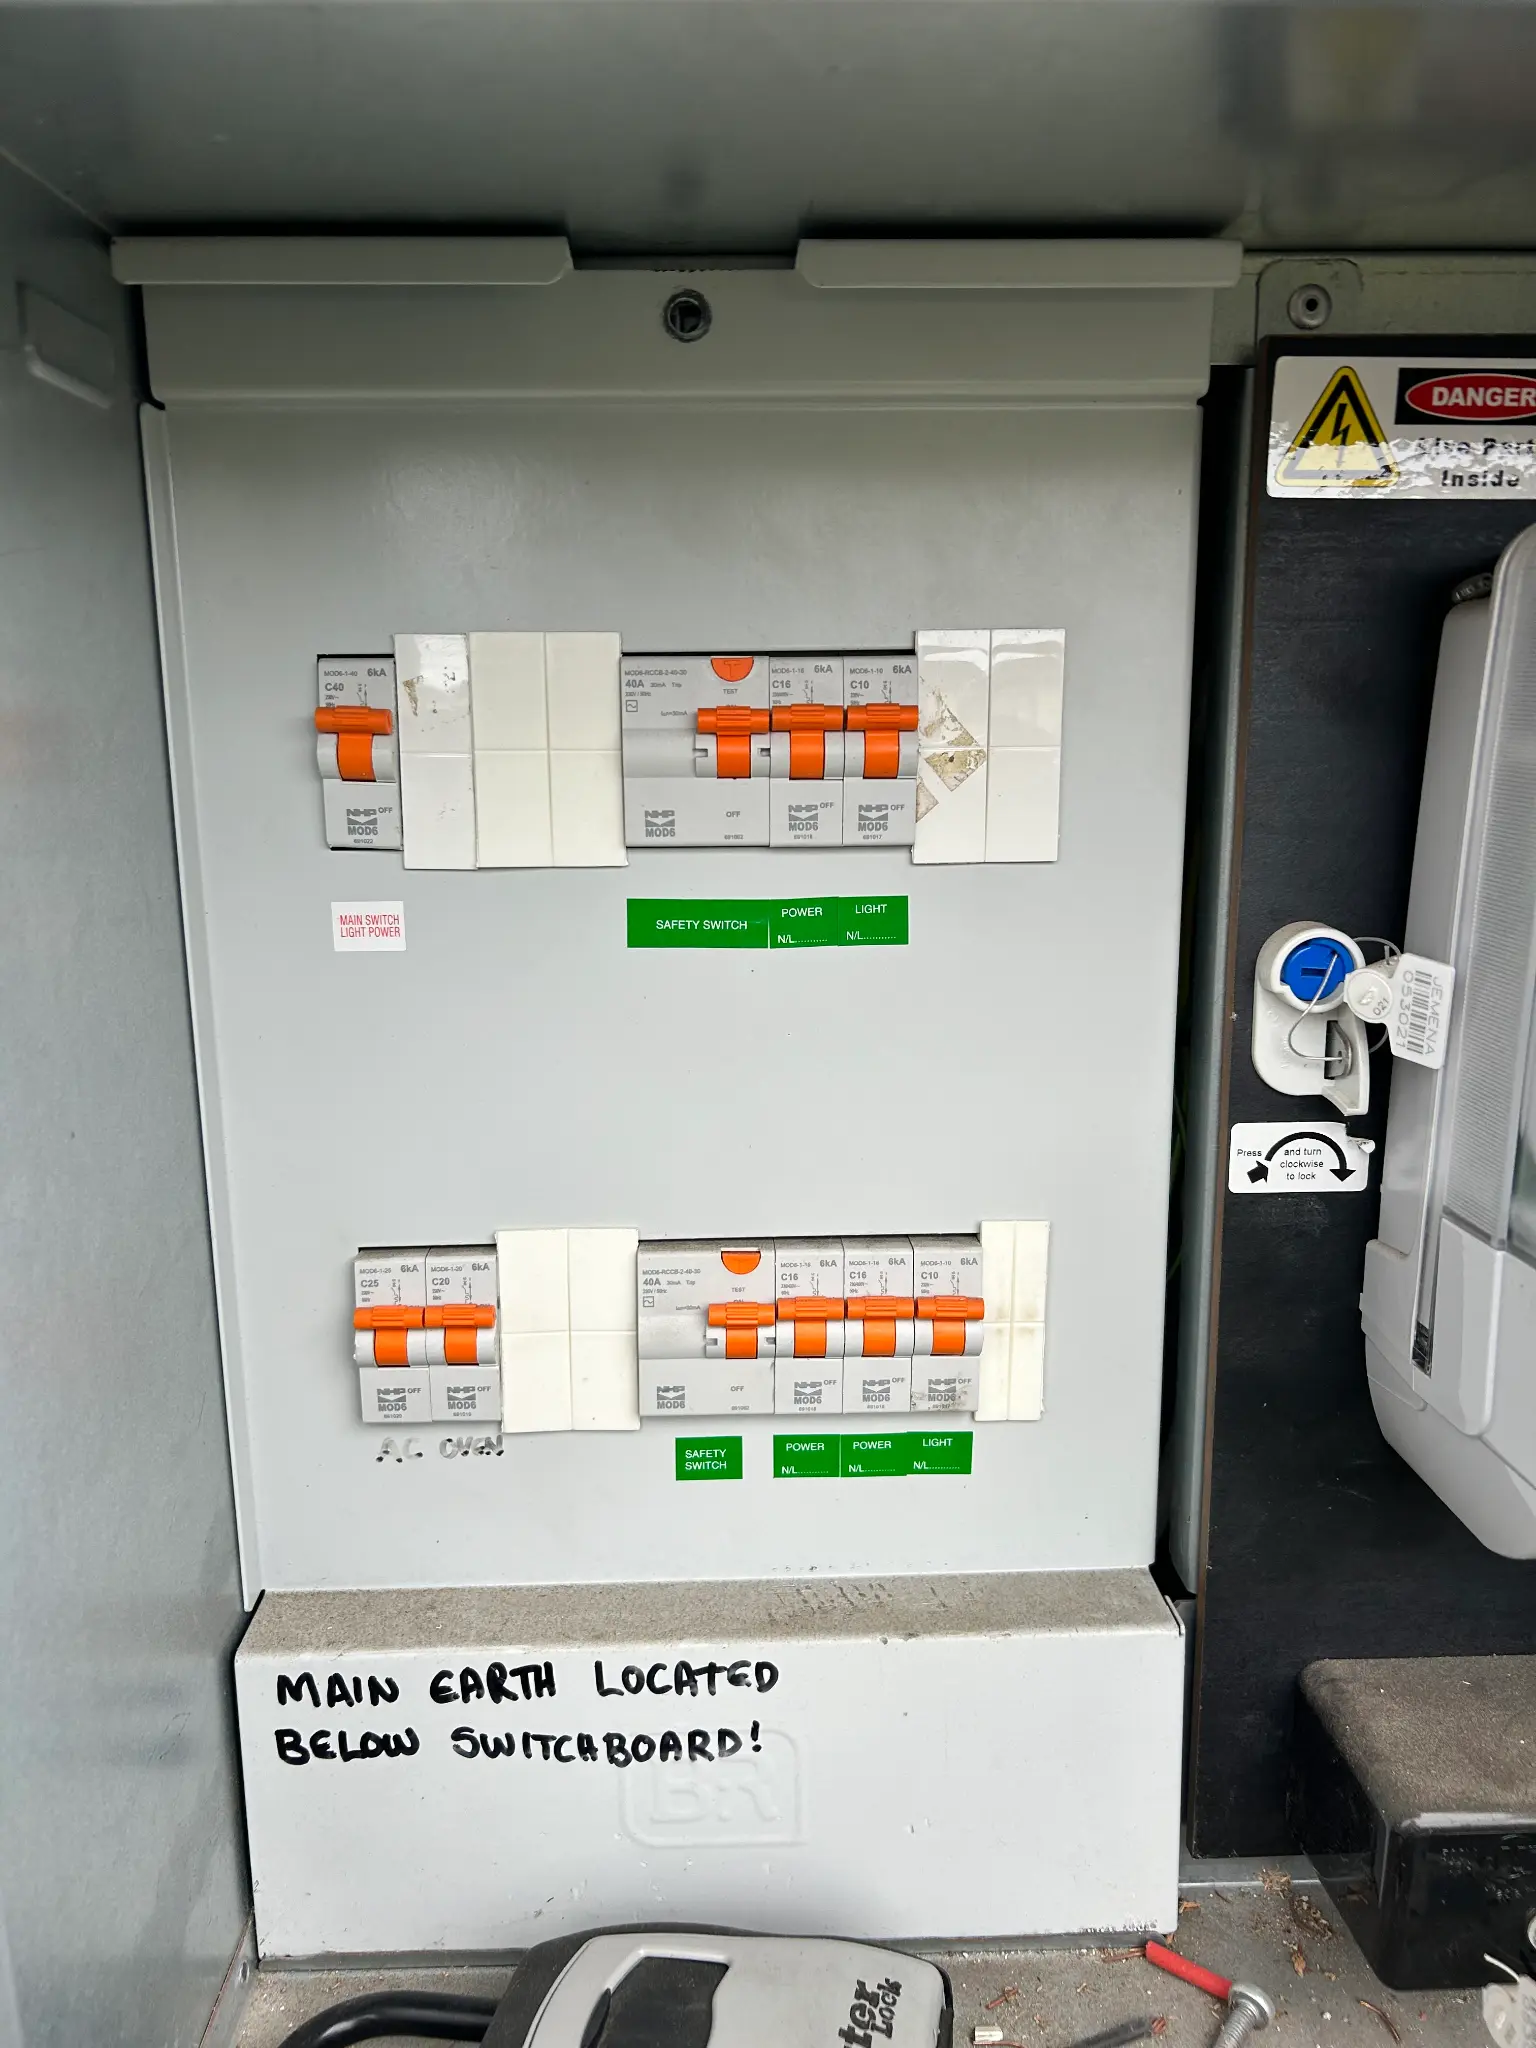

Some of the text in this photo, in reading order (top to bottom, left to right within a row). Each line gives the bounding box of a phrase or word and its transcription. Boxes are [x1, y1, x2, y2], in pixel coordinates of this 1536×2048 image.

[1432, 386, 1536, 407] DANGER
[367, 668, 387, 677] 6kA
[814, 664, 833, 674] 6kA
[892, 664, 912, 674] 6kA
[325, 682, 345, 691] C40
[625, 680, 645, 688] 40A
[772, 680, 791, 689] C16
[850, 680, 870, 689] C10
[346, 808, 377, 816] NHP
[788, 804, 818, 812] NHP
[858, 804, 888, 812] NHP
[644, 810, 675, 818] NHP
[347, 826, 378, 836] MOD6
[788, 822, 819, 832] MOD6
[858, 822, 888, 832] MOD6
[645, 828, 676, 837] MOD6
[781, 907, 823, 917] POWER
[855, 904, 887, 914] LIGHT
[340, 914, 399, 925] MAIN SWITCH
[656, 919, 748, 930] SAFETY SWITCH
[341, 926, 400, 937] LIGHT POWER
[1373, 997, 1389, 1015] 021
[1396, 970, 1413, 1048] 053021
[1425, 976, 1443, 1055] JEMENA
[1237, 1148, 1322, 1157] Press and turn
[1280, 1160, 1324, 1168] clockwise
[1286, 1172, 1316, 1180] to lock
[819, 1259, 838, 1268] 6kA
[888, 1257, 906, 1266] 6kA
[960, 1257, 979, 1266] 6kA
[400, 1264, 419, 1273] 6kA
[471, 1262, 490, 1271] 6kA
[781, 1272, 799, 1281] C16
[849, 1271, 867, 1280] C16
[920, 1271, 939, 1280] C10
[360, 1279, 379, 1288] C25
[432, 1277, 450, 1286] C20
[643, 1277, 661, 1286] 40A
[794, 1381, 822, 1389] NHP
[862, 1379, 890, 1387] NHP
[928, 1378, 956, 1386] NHP
[656, 1385, 685, 1393] NHP
[794, 1395, 822, 1405] MOD6
[862, 1393, 890, 1402] MOD6
[928, 1393, 956, 1402] MOD6
[378, 1402, 407, 1412] MOD6
[448, 1401, 476, 1410] MOD6
[657, 1400, 685, 1410] MOD6
[853, 1441, 892, 1450] POWER
[923, 1438, 953, 1447] LIGHT
[786, 1443, 824, 1452] POWER
[685, 1449, 727, 1459] SAFETY
[685, 1461, 727, 1470] SWITCH
[276, 1659, 780, 1708] MAIN EARTH LOCATED
[275, 1720, 764, 1769] BELOW SWITCHBOARD!
[870, 1977, 902, 2039] Lock
[838, 1979, 880, 2048] ter
